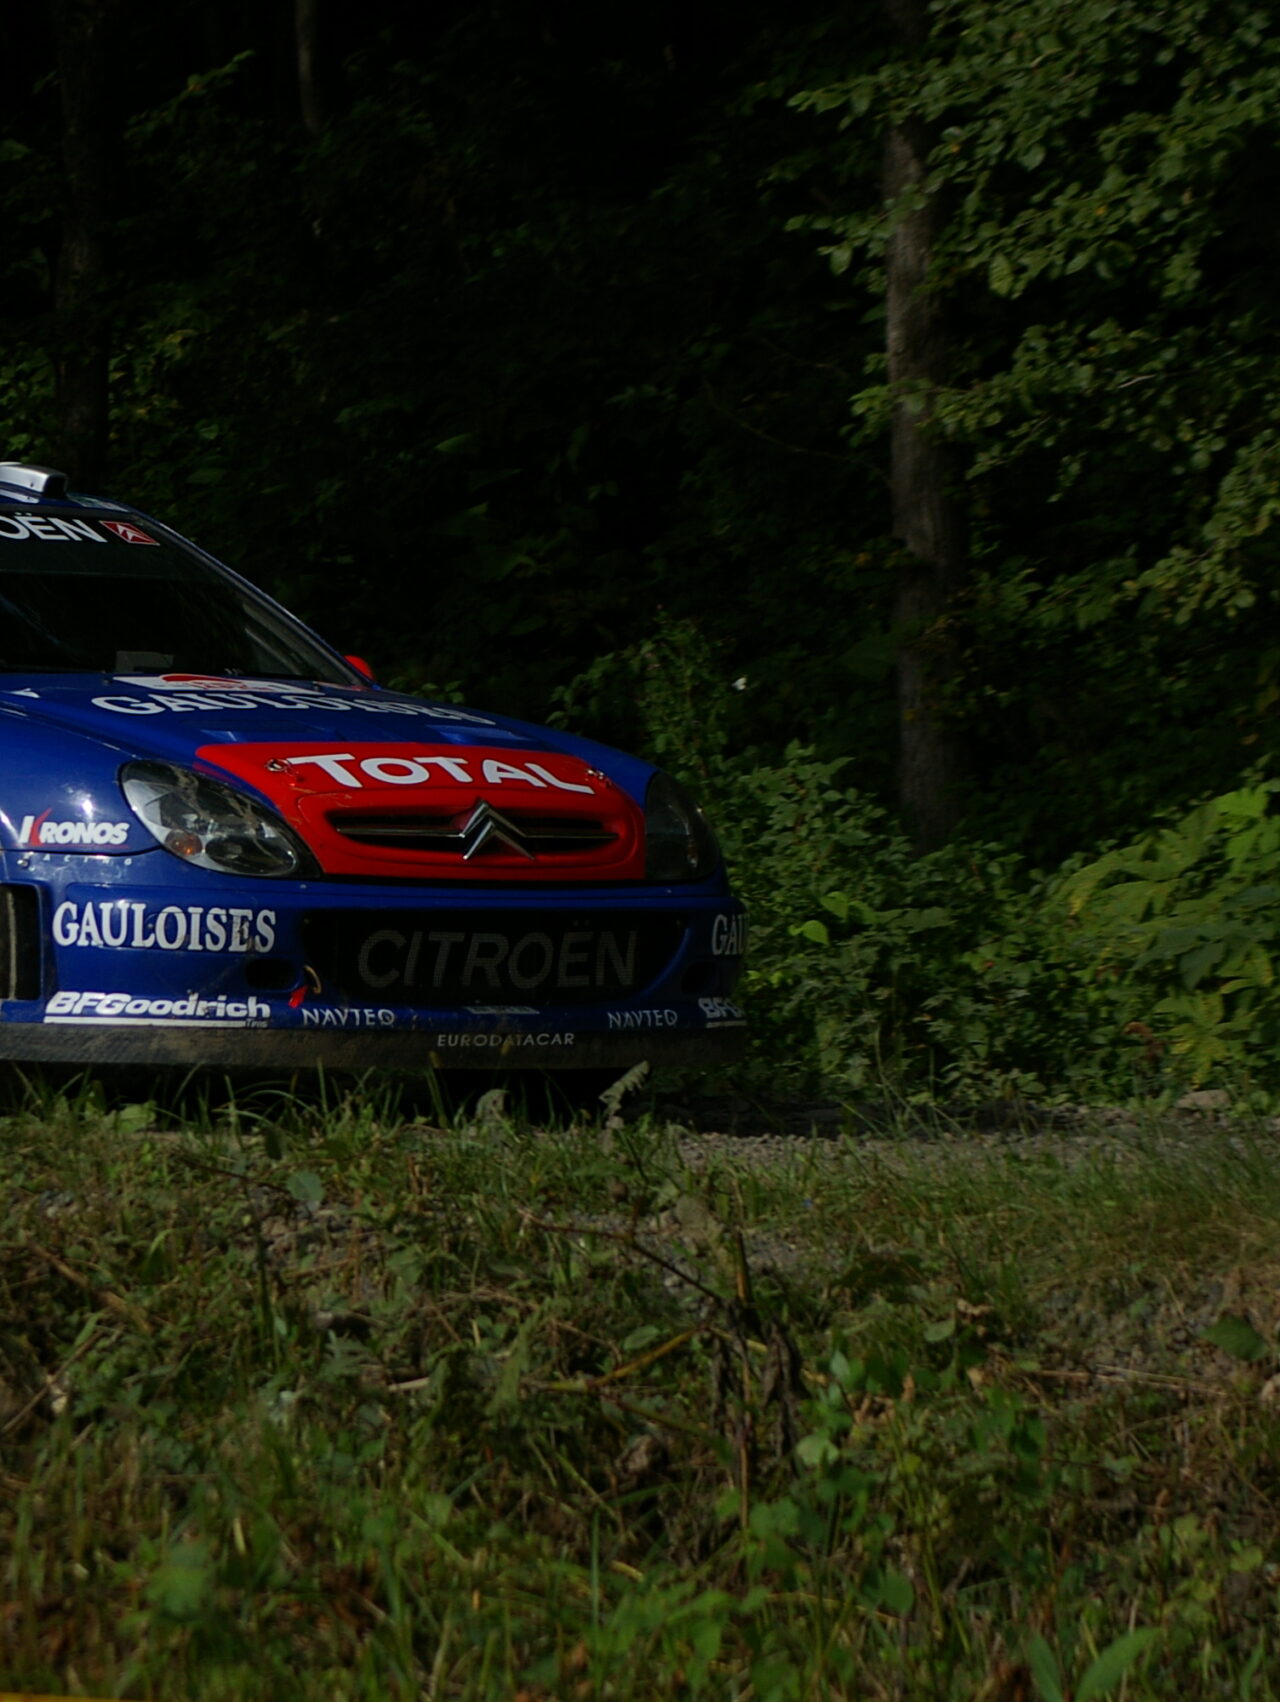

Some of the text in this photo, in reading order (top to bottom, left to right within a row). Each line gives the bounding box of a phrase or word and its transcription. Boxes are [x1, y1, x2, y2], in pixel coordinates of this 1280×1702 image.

[286, 753, 596, 795] TOTAL
[19, 808, 130, 847] KRONOS
[52, 901, 277, 953] GAULOISES
[357, 919, 639, 989] CITROËN
[45, 988, 271, 1019] BFGoodrich
[301, 1007, 396, 1028] NAVTEQ
[607, 1009, 679, 1029] NAVTEQ
[436, 1032, 576, 1047] EURODATACAR
